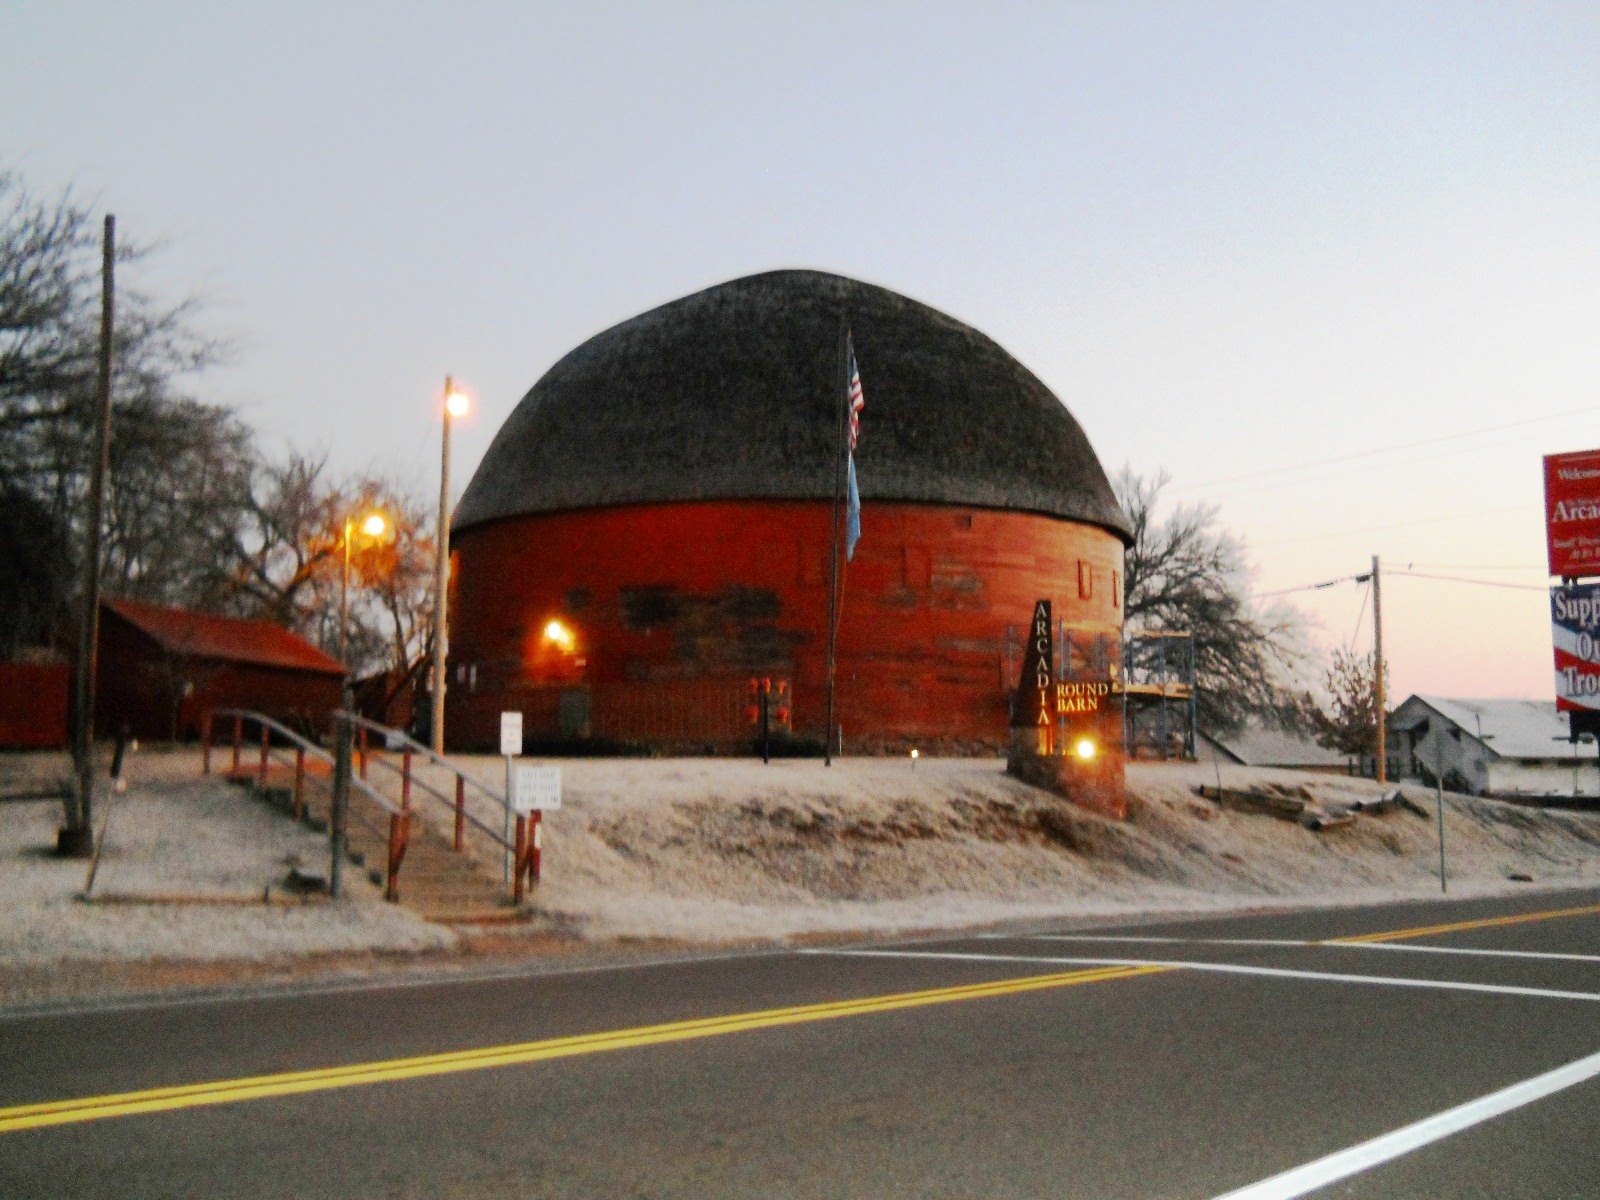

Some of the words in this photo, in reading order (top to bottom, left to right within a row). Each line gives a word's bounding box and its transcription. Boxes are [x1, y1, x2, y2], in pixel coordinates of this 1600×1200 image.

[1551, 500, 1600, 522] Arca
[1036, 602, 1050, 725] ARCADIA
[1057, 683, 1109, 696] ROUND
[1563, 666, 1600, 696] Tro
[1057, 698, 1098, 712] BARN
